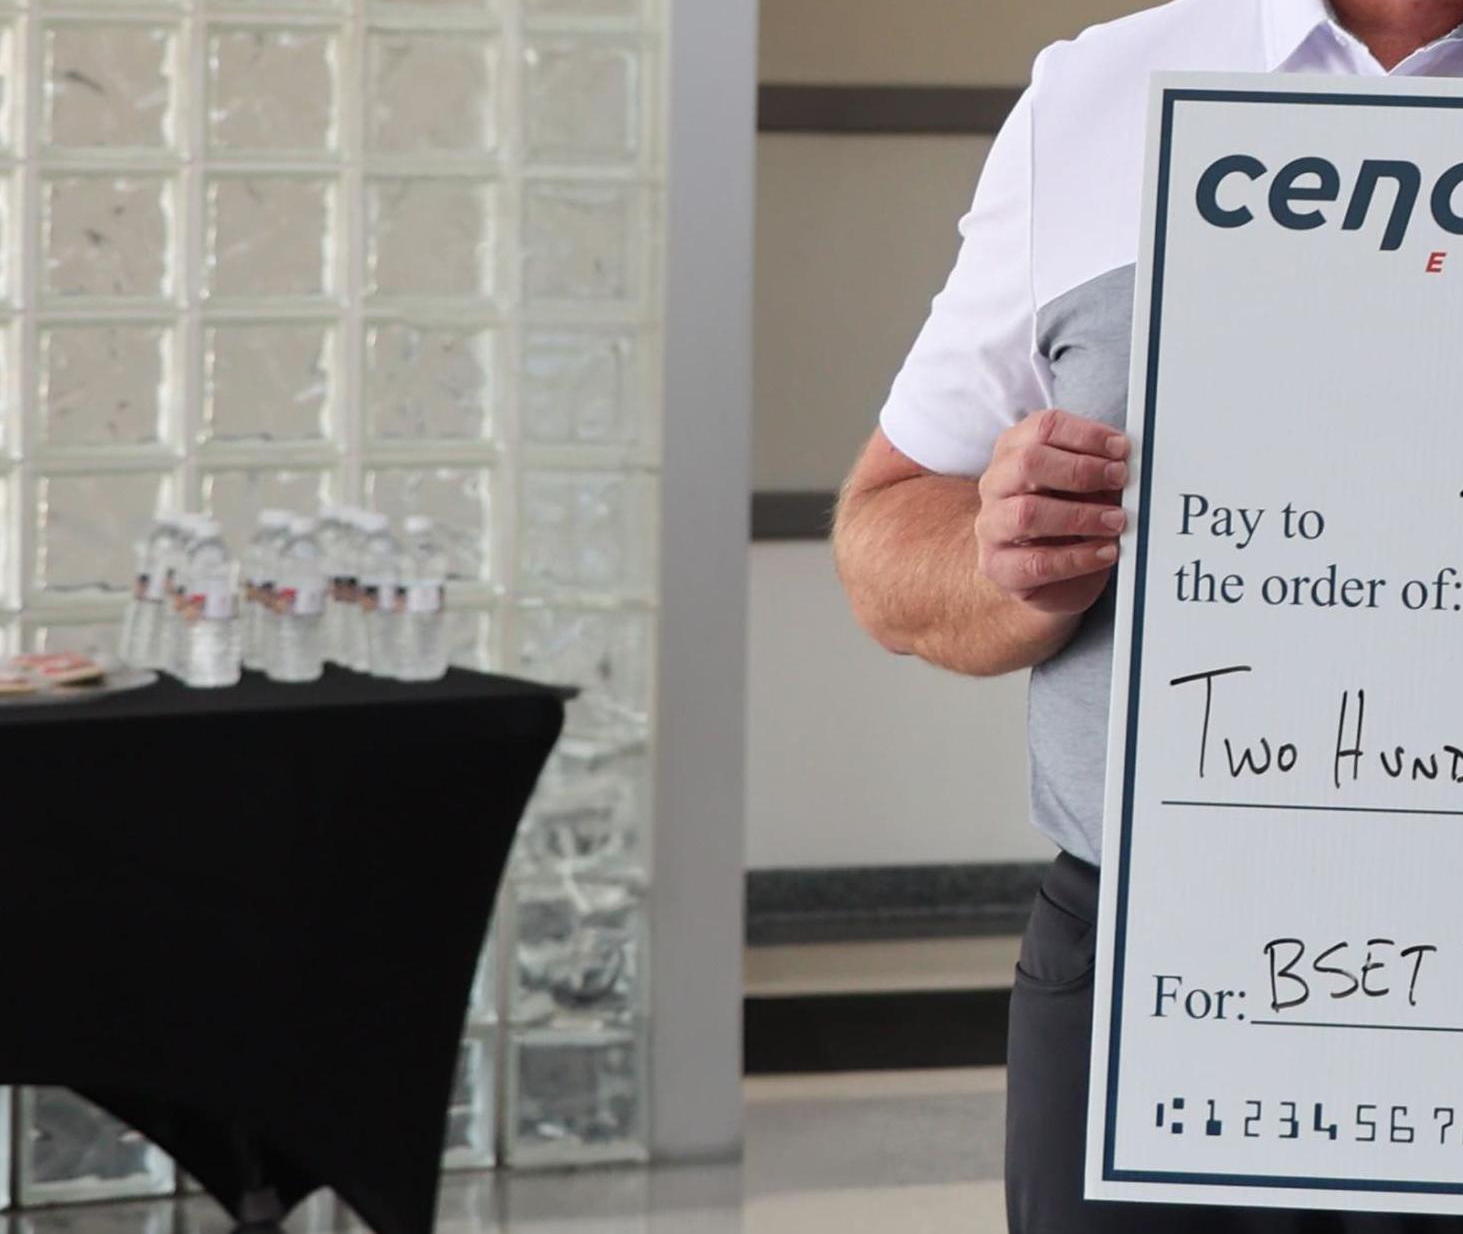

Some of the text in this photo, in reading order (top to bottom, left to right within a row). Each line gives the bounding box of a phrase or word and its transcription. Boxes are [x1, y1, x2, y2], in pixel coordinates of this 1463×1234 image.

[1180, 494, 1324, 549] Pay to
[1174, 562, 1461, 611] the order of:
[1153, 976, 1245, 1020] For:
[1264, 938, 1437, 1012] BSET
